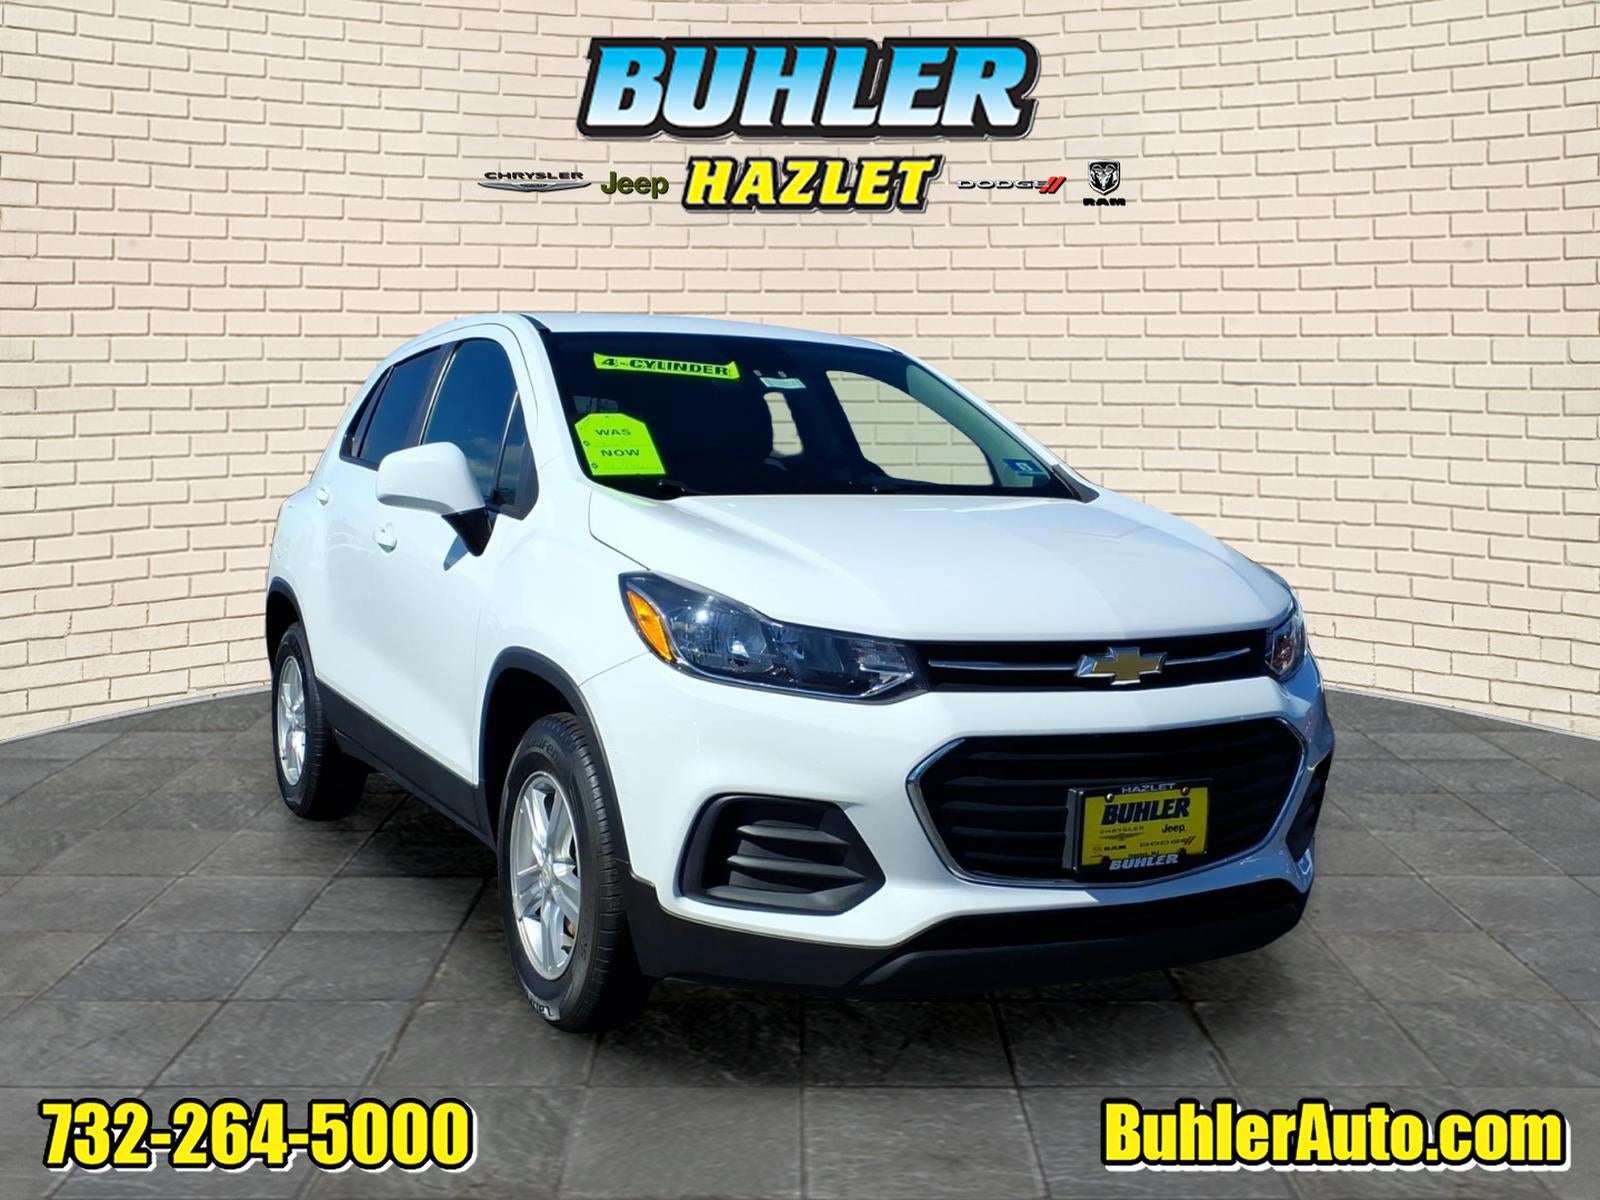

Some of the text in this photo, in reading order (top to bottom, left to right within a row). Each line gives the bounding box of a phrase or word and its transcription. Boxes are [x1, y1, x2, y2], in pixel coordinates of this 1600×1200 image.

[595, 428, 632, 437] WAS
[600, 449, 641, 457] NOW
[1121, 783, 1176, 794] HAZLET
[1101, 797, 1191, 825] BUHLER
[1099, 825, 1145, 834] CHRYSLER
[1161, 823, 1186, 834] Jeep
[1103, 844, 1127, 852] RAM
[1109, 853, 1179, 871] BUHLER
